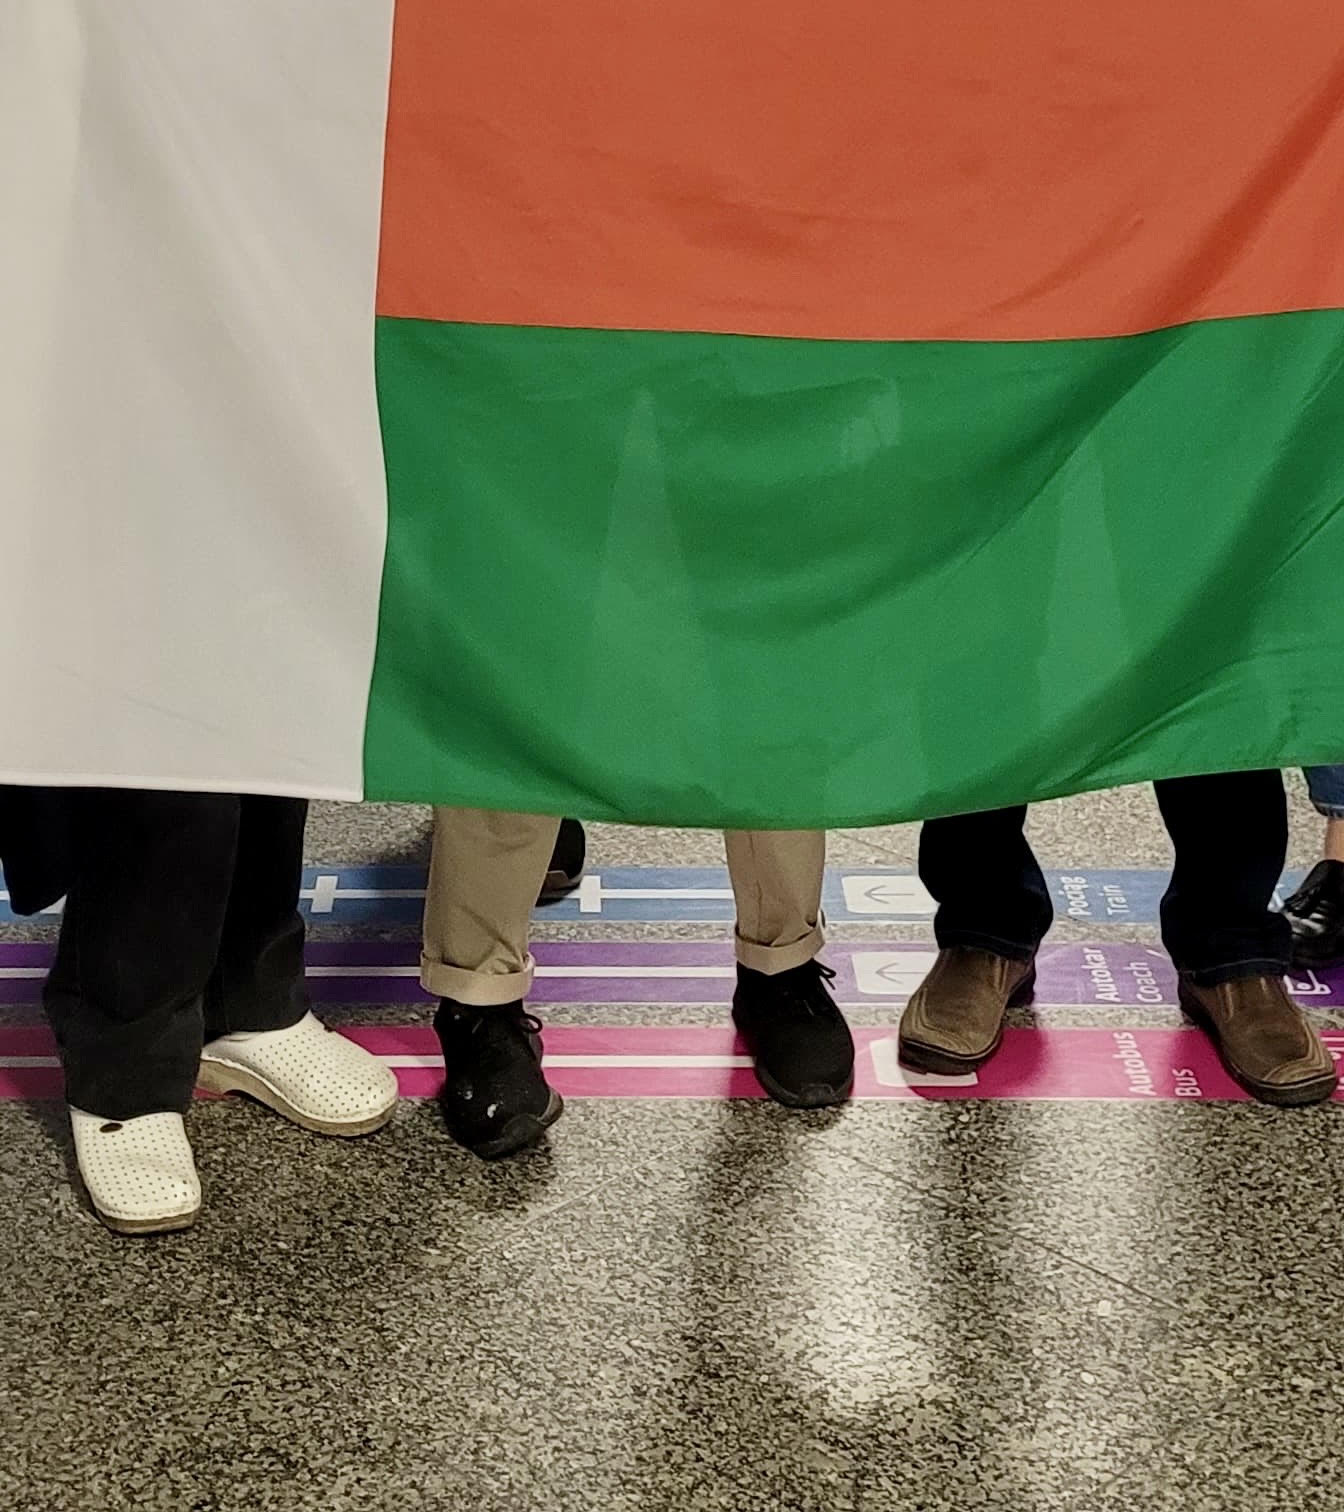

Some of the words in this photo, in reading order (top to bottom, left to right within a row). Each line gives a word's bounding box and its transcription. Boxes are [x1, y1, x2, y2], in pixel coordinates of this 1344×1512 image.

[1060, 876, 1093, 916] Pociąg
[1098, 884, 1131, 916] Train
[1081, 948, 1121, 1003] Autokar
[1123, 962, 1163, 1003] Coach
[1112, 1031, 1157, 1097] Autobus
[1171, 1068, 1203, 1097] Bus
